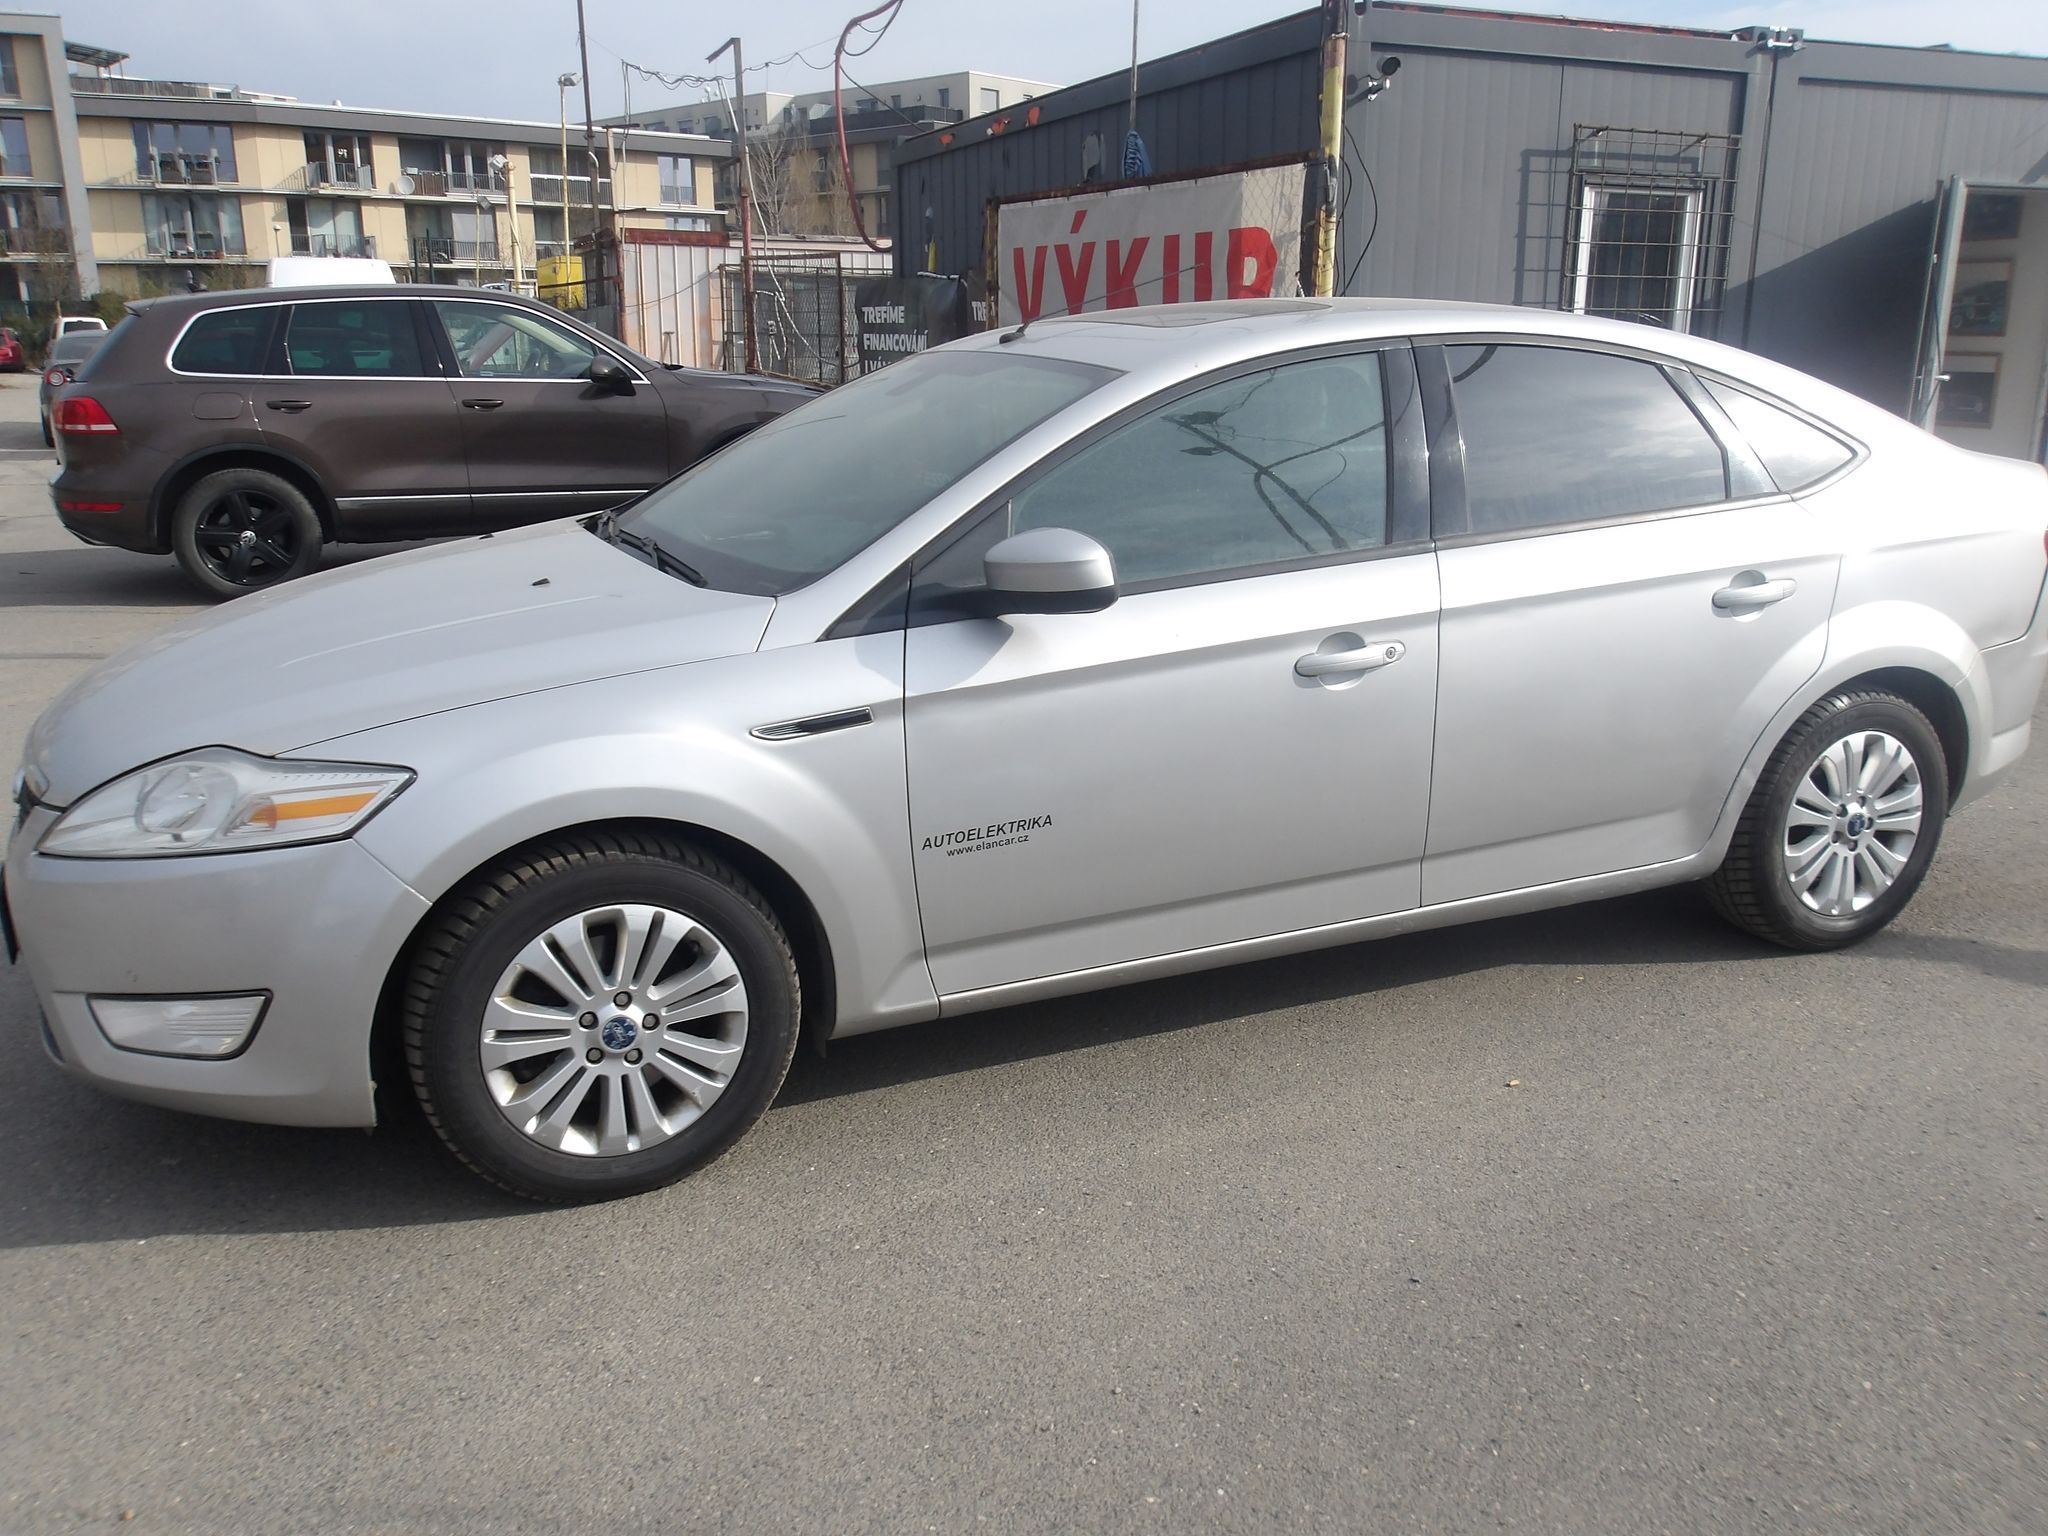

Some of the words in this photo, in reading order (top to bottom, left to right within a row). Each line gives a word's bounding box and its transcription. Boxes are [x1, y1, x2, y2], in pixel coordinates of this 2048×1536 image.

[1013, 210, 1278, 323] VÝKUP
[862, 301, 905, 324] TREFÍME
[863, 329, 929, 353] FINANCOVÁNÍ
[921, 814, 1053, 851] AUTOELEKTRIKA
[946, 834, 1030, 857] www.elancar.cz
